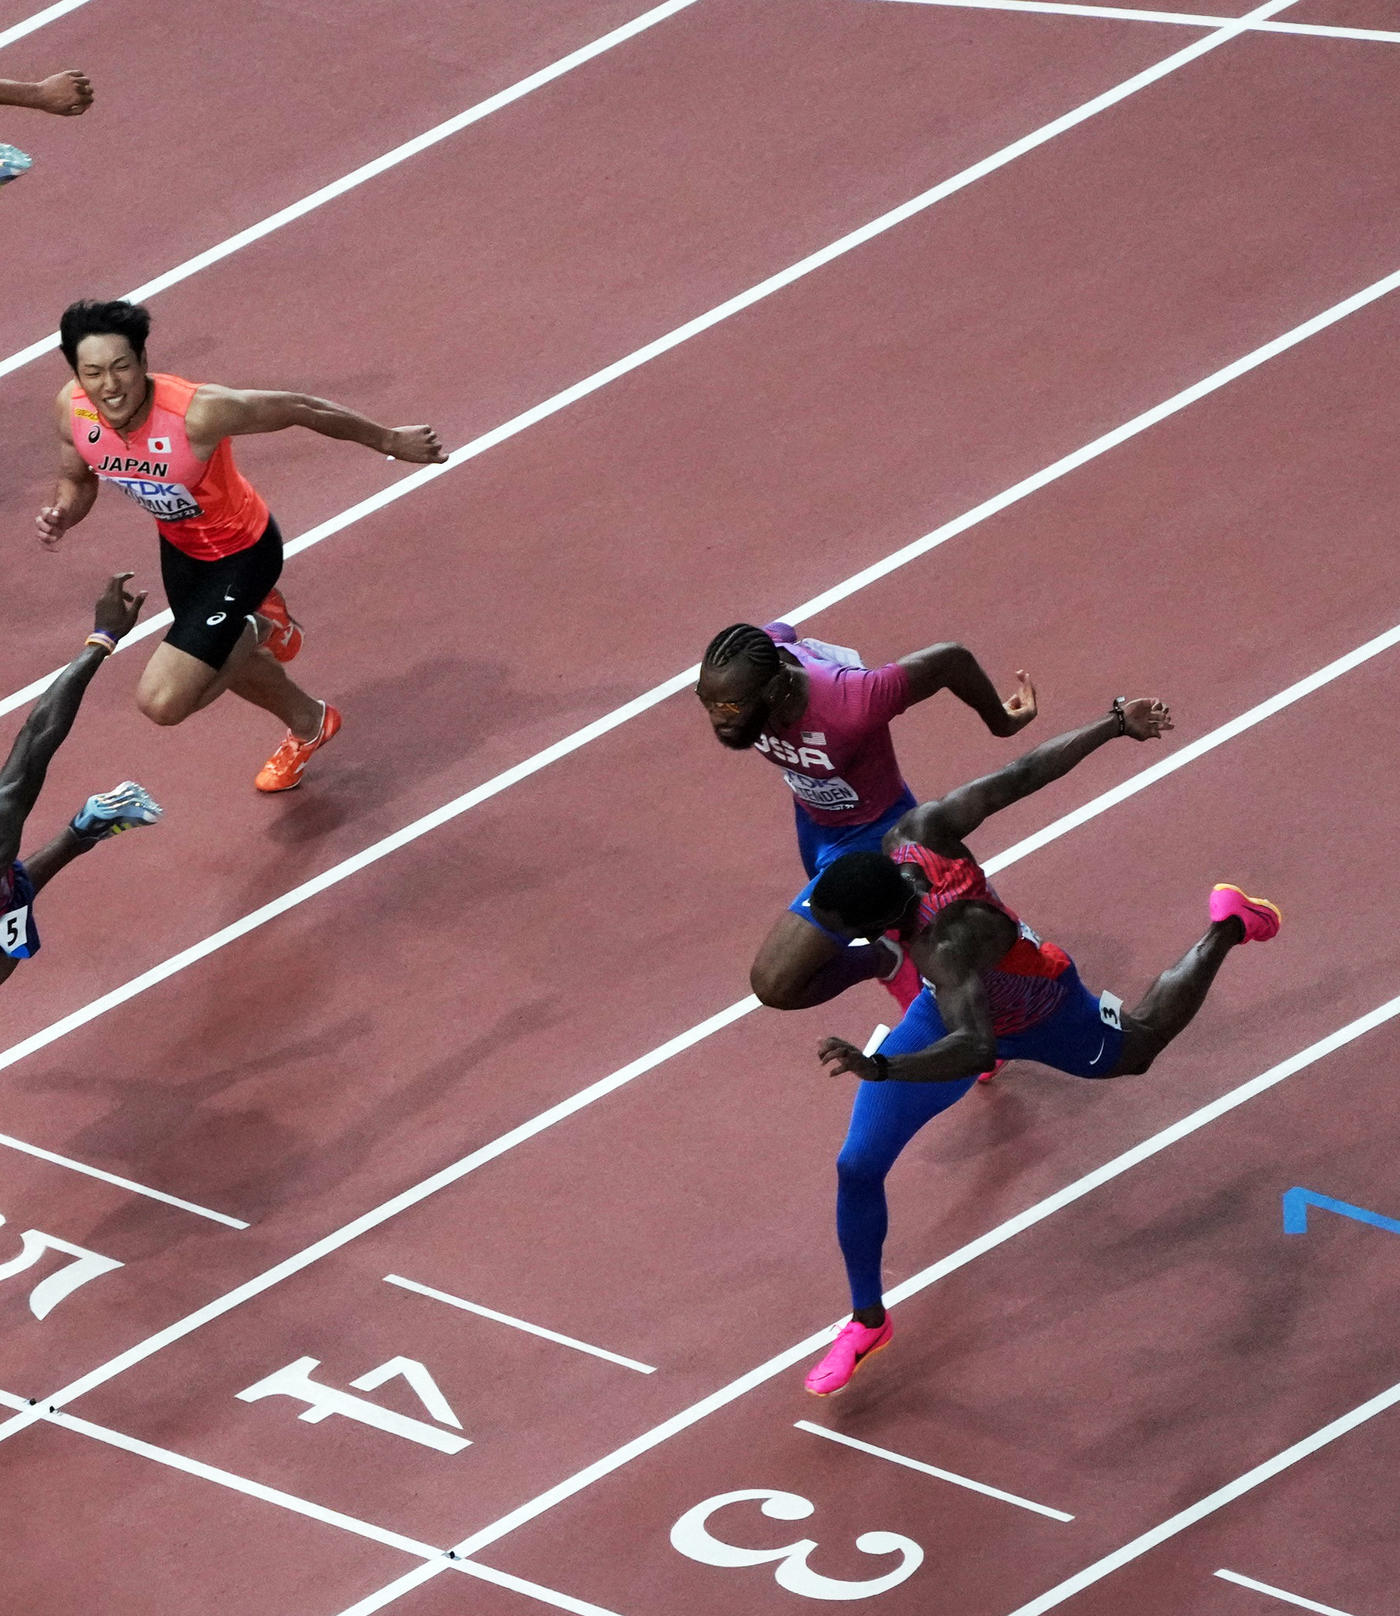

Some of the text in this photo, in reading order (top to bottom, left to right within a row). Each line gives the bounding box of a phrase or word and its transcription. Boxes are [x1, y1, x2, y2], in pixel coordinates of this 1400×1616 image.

[97, 455, 168, 477] JAPAN
[118, 479, 183, 496] TDK
[6, 917, 18, 947] 5
[1103, 1006, 1119, 1024] 3
[235, 1356, 473, 1454] 4
[670, 1489, 923, 1600] 3
